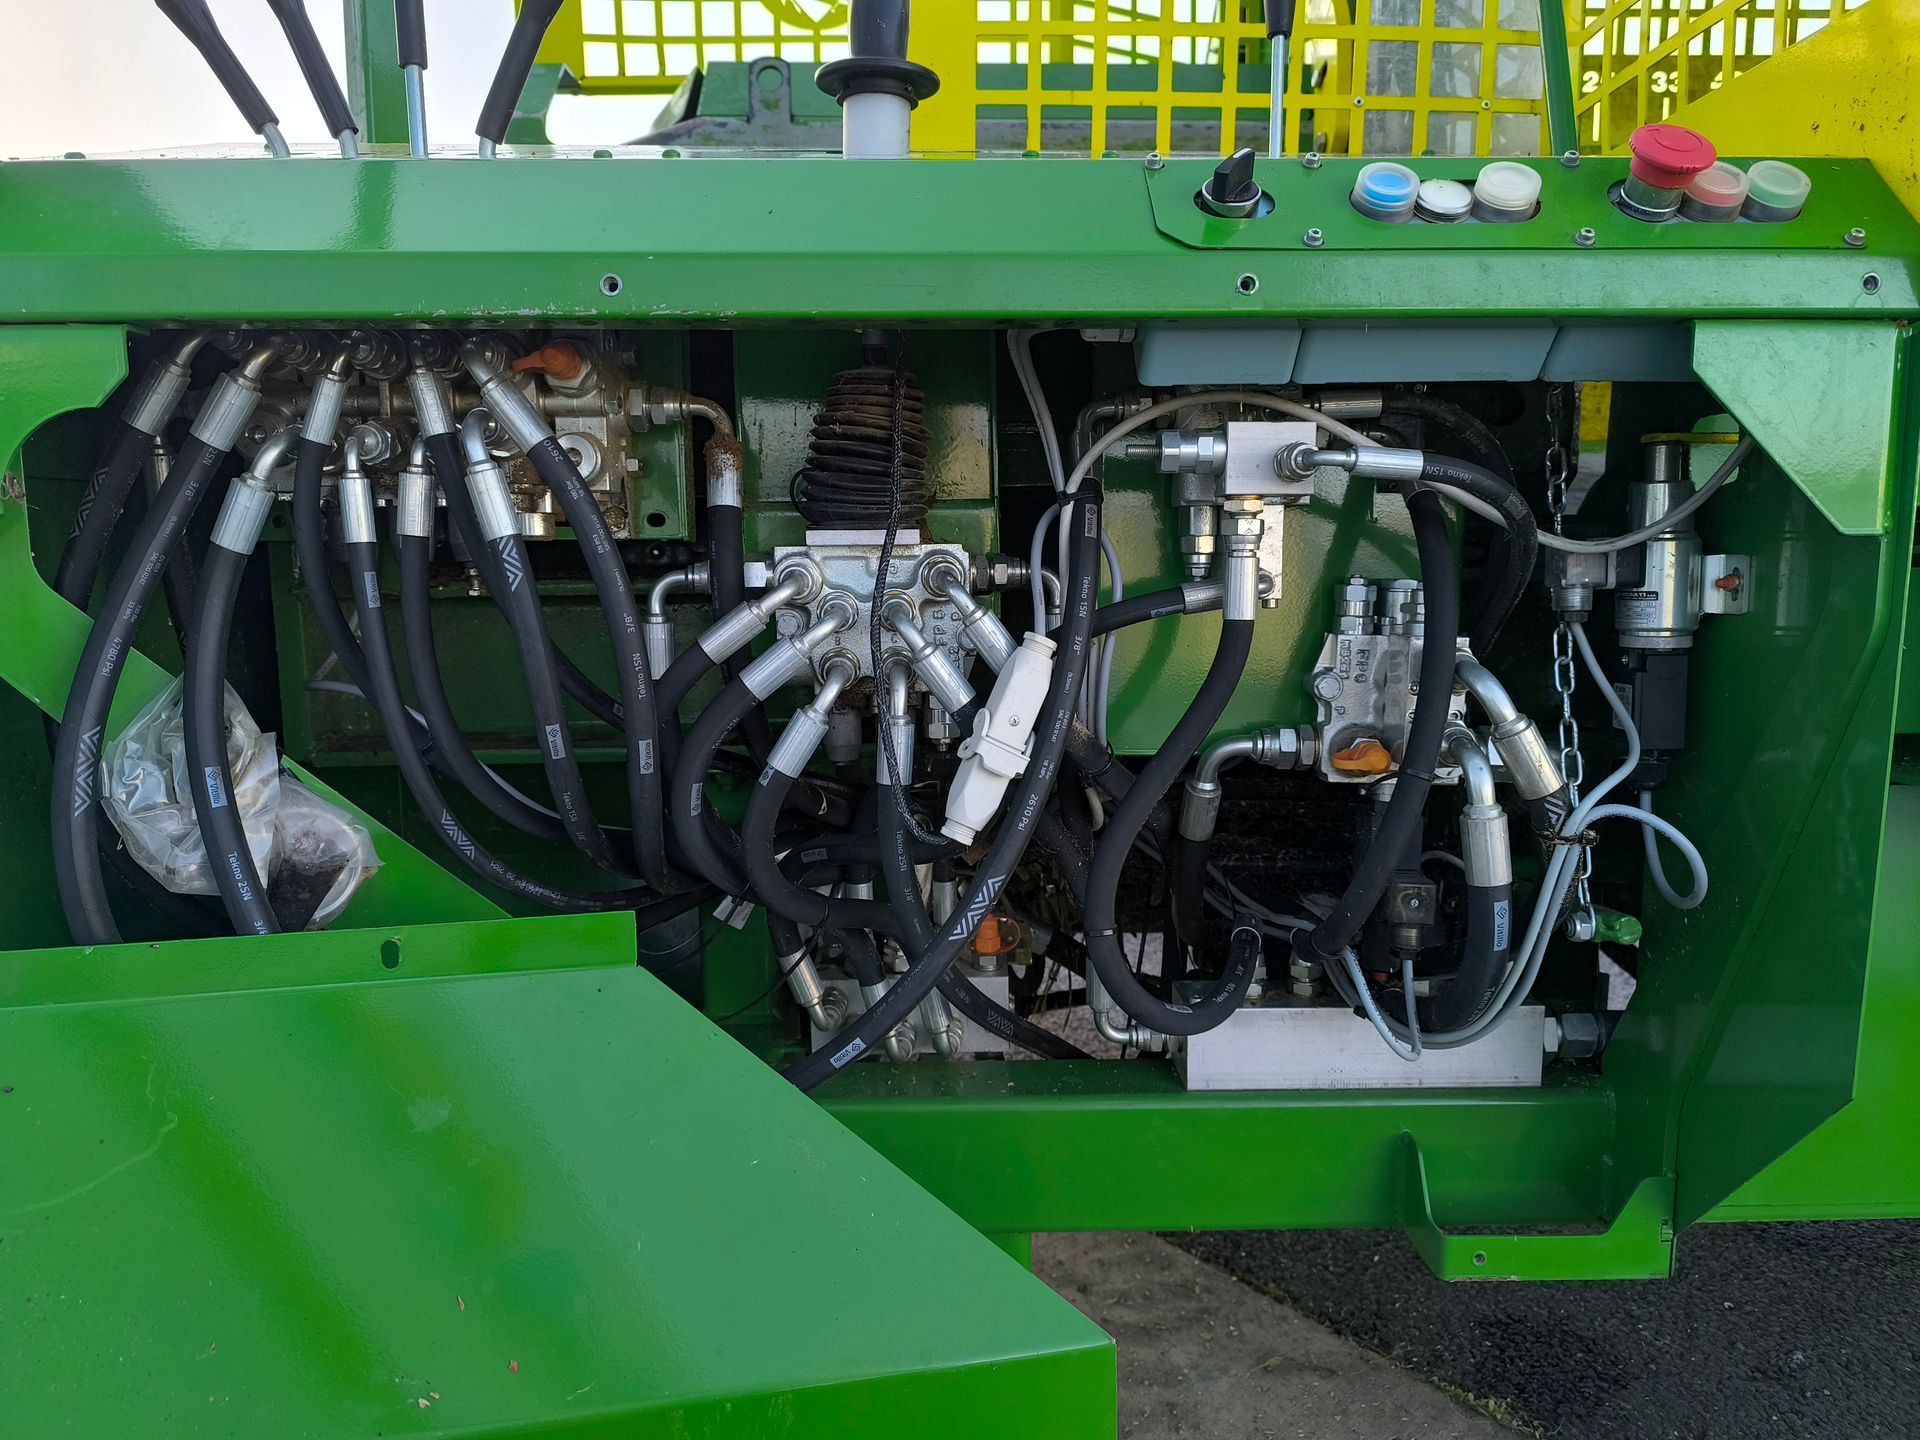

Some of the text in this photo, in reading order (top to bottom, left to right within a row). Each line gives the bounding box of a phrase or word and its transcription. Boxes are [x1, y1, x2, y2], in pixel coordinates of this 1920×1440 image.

[543, 437, 563, 463] 2610
[1425, 465, 1472, 482] Tekno 1SN
[595, 542, 603, 553] EN
[1080, 575, 1091, 598] Tekno
[1079, 600, 1087, 617] 1SN
[101, 636, 122, 676] 4780 Psi
[633, 653, 647, 699] Tekno 1SN
[551, 739, 559, 756] Vitillo
[1016, 794, 1039, 830] 2610 Psi
[894, 830, 907, 853] Tekno
[898, 855, 907, 871] 2SN
[225, 851, 246, 880] Tekno
[237, 880, 252, 900] 2SN
[1496, 923, 1504, 947] Vitillo
[832, 1049, 851, 1063] Vitillo
